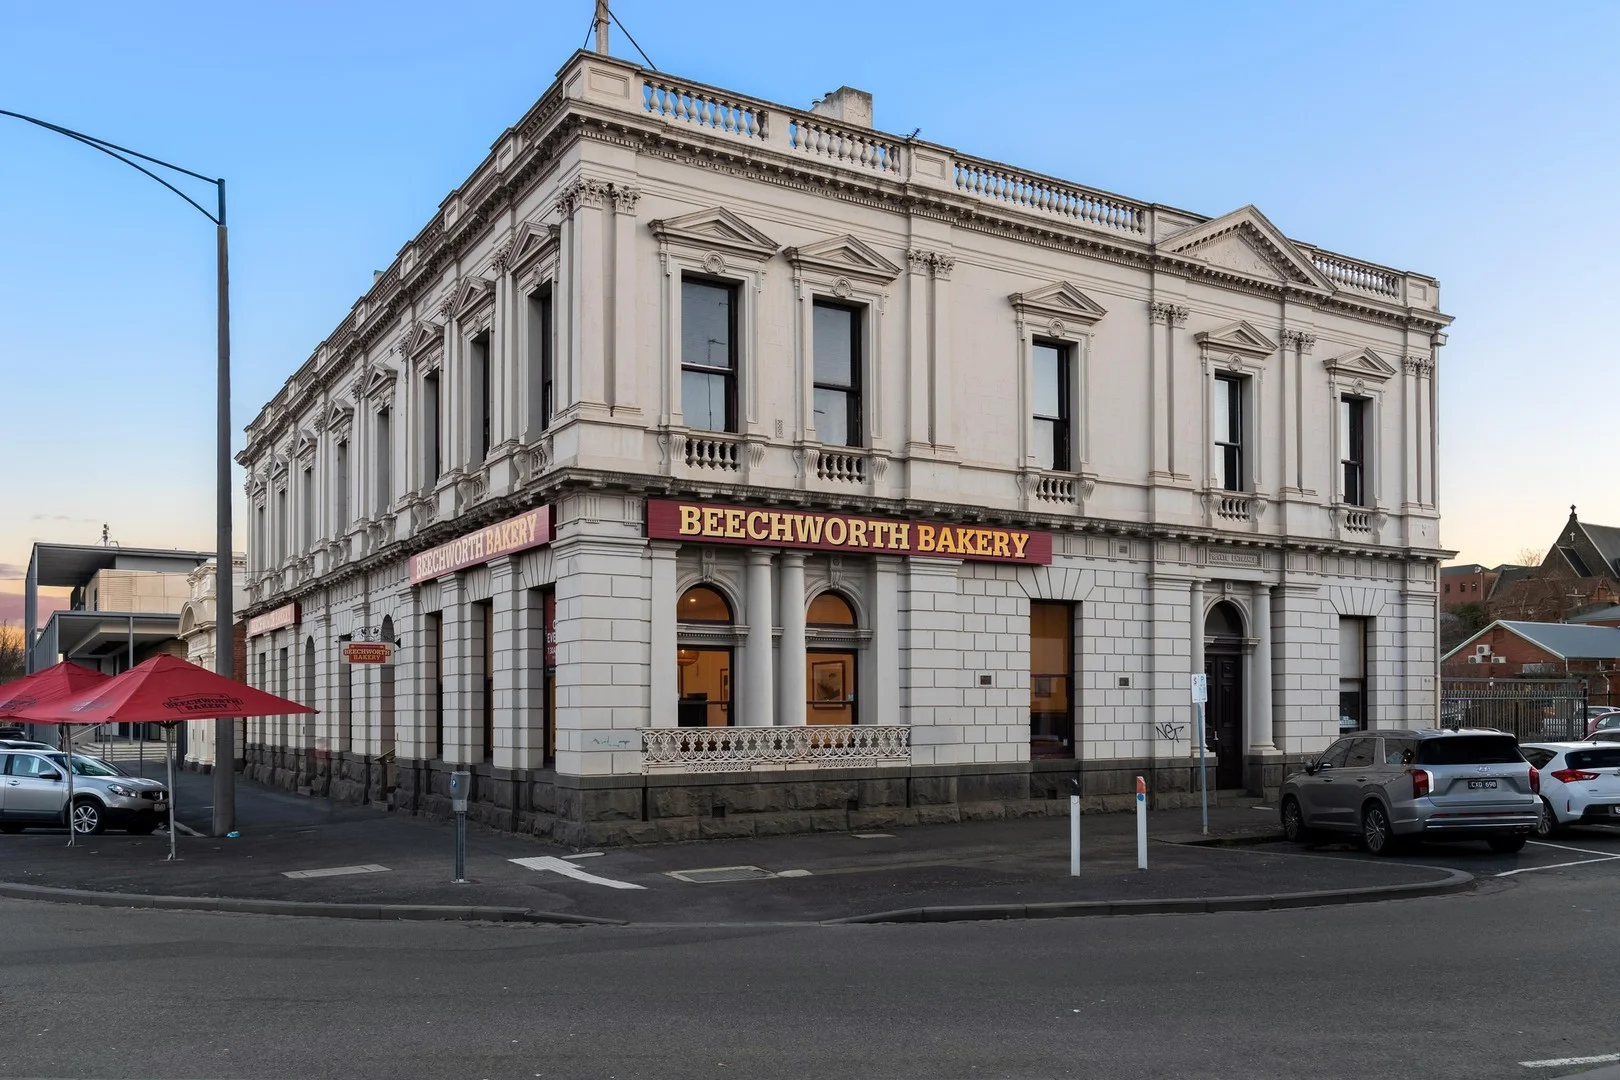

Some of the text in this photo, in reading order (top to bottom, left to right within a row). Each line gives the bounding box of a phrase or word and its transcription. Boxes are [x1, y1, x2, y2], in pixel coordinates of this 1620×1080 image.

[416, 513, 537, 580] BEECHWORTH BAKERY
[679, 505, 1029, 559] BEECHWORTH BAKERY
[166, 698, 241, 708] BEECHWORTH
